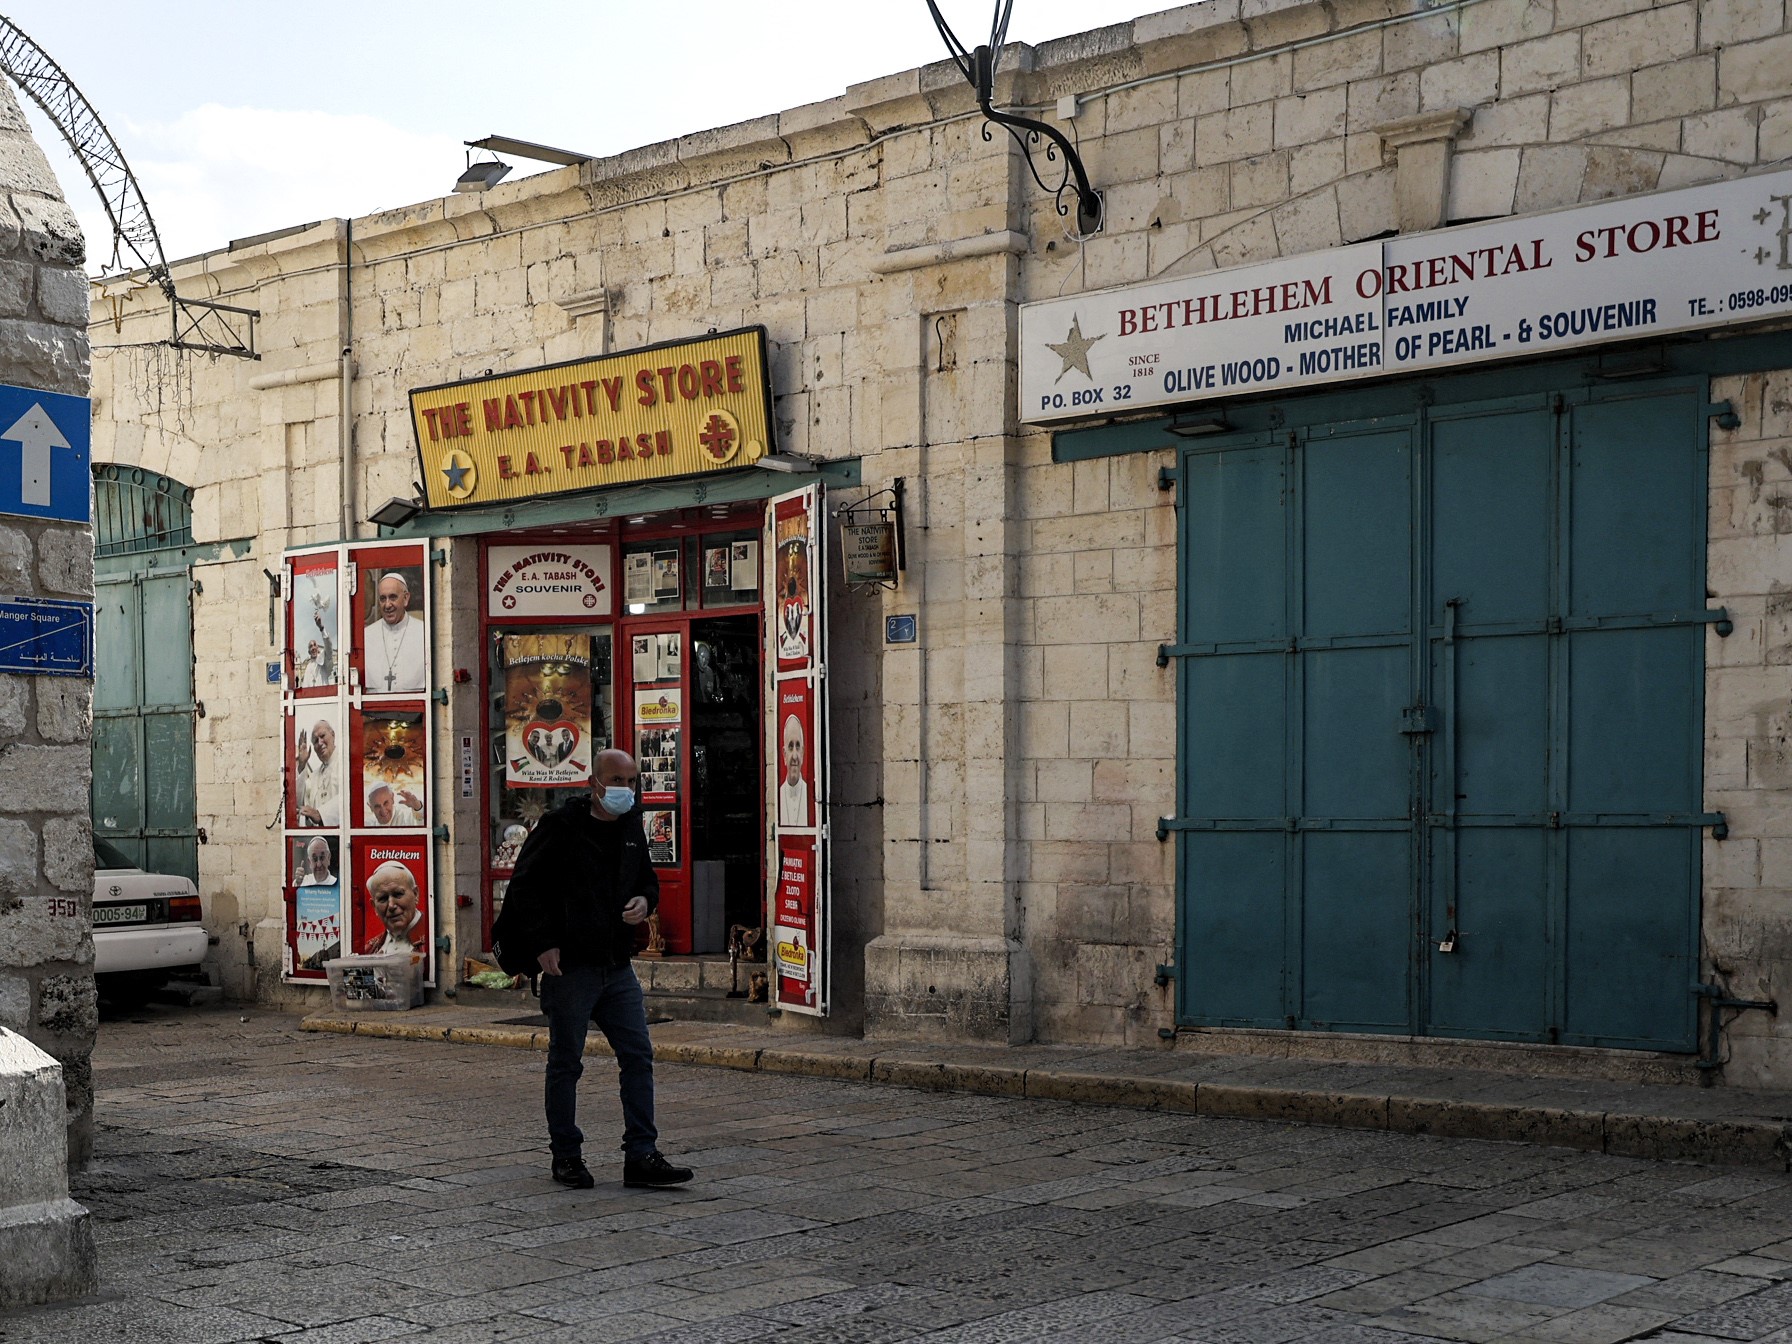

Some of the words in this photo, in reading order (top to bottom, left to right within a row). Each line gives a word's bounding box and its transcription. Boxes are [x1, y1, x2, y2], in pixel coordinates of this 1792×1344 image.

[1118, 276, 1333, 336] BETHLEHEM
[1356, 238, 1552, 298] ORIENTAL
[1576, 209, 1720, 262] STORE
[1284, 312, 1379, 344] MICHAEL
[1388, 296, 1470, 328] FAMILY
[1164, 365, 1216, 394] OLIVE
[1222, 356, 1280, 386] WOOD
[1300, 342, 1381, 376] MOTHER
[1395, 334, 1422, 361] OF
[1428, 324, 1496, 356] PEARL
[1518, 318, 1532, 343] &
[1538, 298, 1656, 340] SOUVENIR
[1128, 354, 1160, 366] SINCE
[1132, 367, 1154, 378] 1818
[422, 402, 472, 442] THE
[482, 376, 622, 432] NATIVITY
[636, 356, 744, 406] STORE
[1072, 388, 1104, 406] BOX
[1113, 384, 1132, 400] 32
[560, 430, 672, 470] TABASH
[492, 570, 514, 593] THE
[512, 552, 572, 572] NATIVITY
[572, 560, 606, 592] STORE
[544, 572, 577, 580] TABASH
[516, 585, 582, 593] SOUVENIR
[30, 612, 60, 624] Square
[890, 620, 896, 628] 2
[370, 848, 420, 860] Bethlehem
